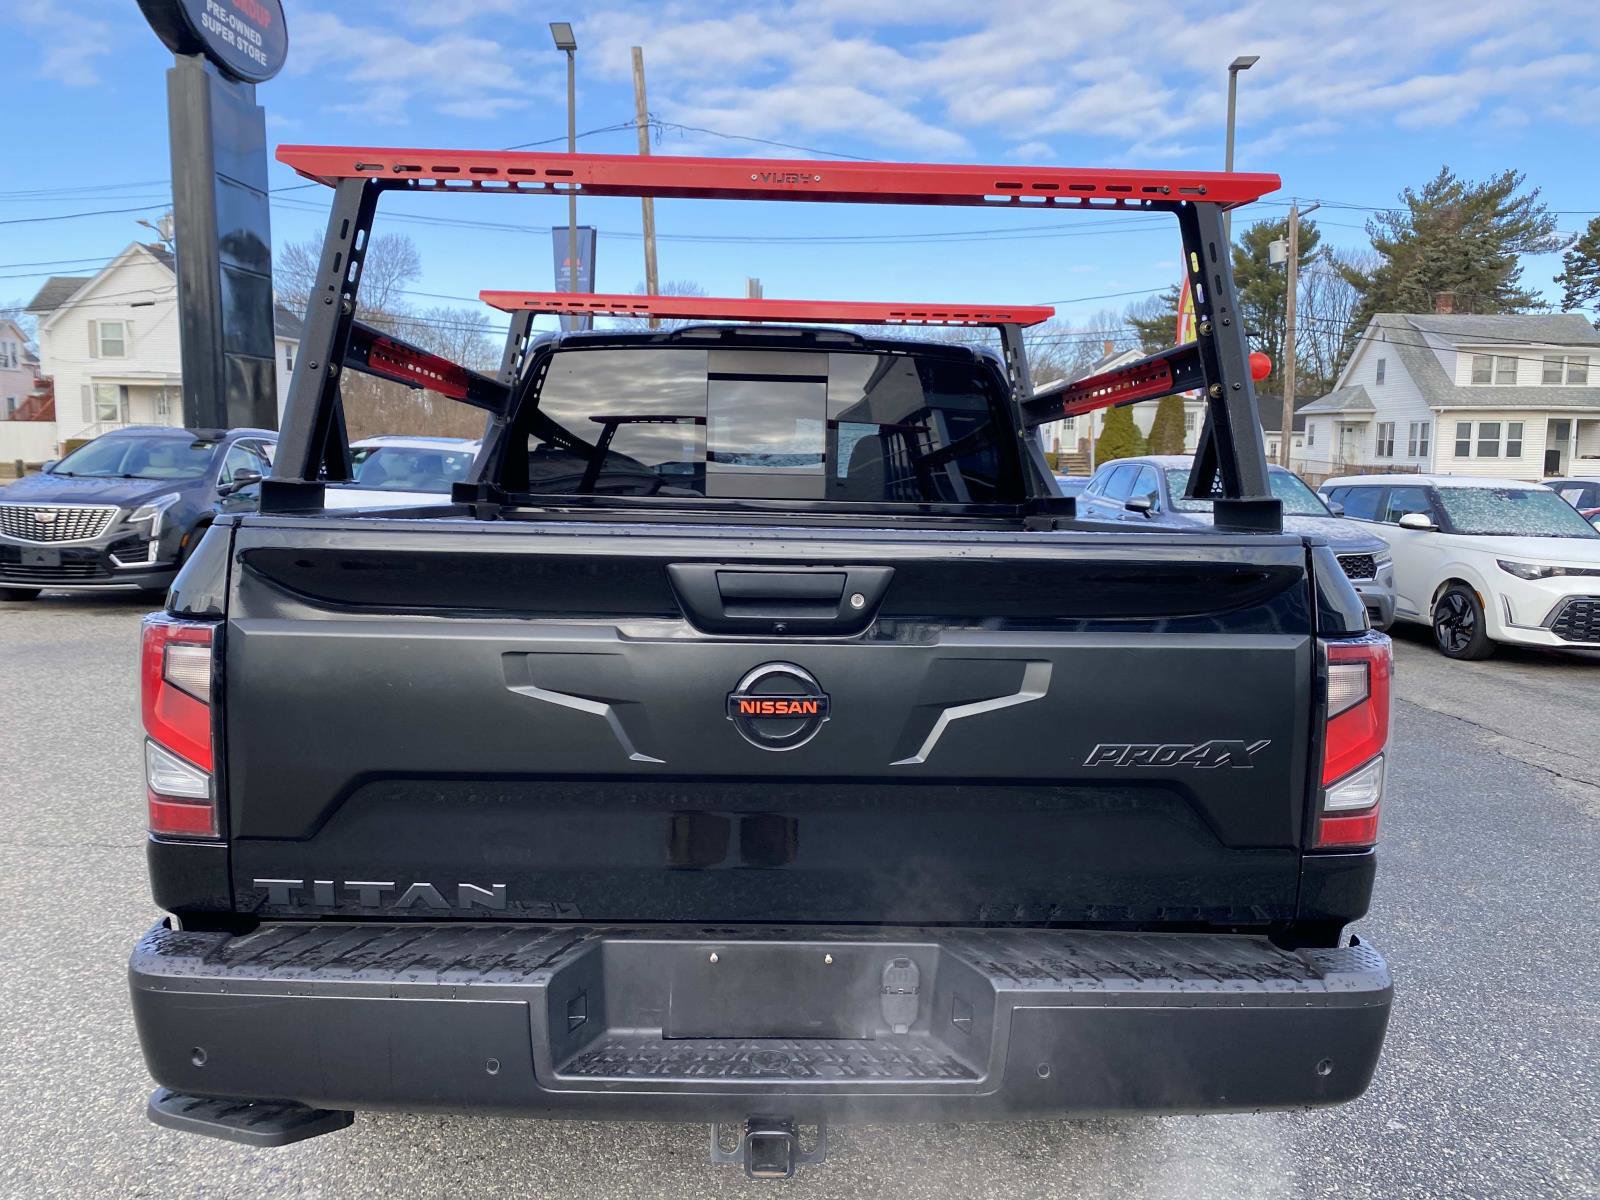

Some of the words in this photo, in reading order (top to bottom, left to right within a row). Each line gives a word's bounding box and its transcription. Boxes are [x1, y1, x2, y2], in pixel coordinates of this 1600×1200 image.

[201, 12, 235, 46] SUPER
[236, 36, 267, 66] STORE
[206, 0, 262, 46] PRE-OWNED
[740, 701, 817, 714] NISSAN
[253, 878, 507, 910] TITAN
